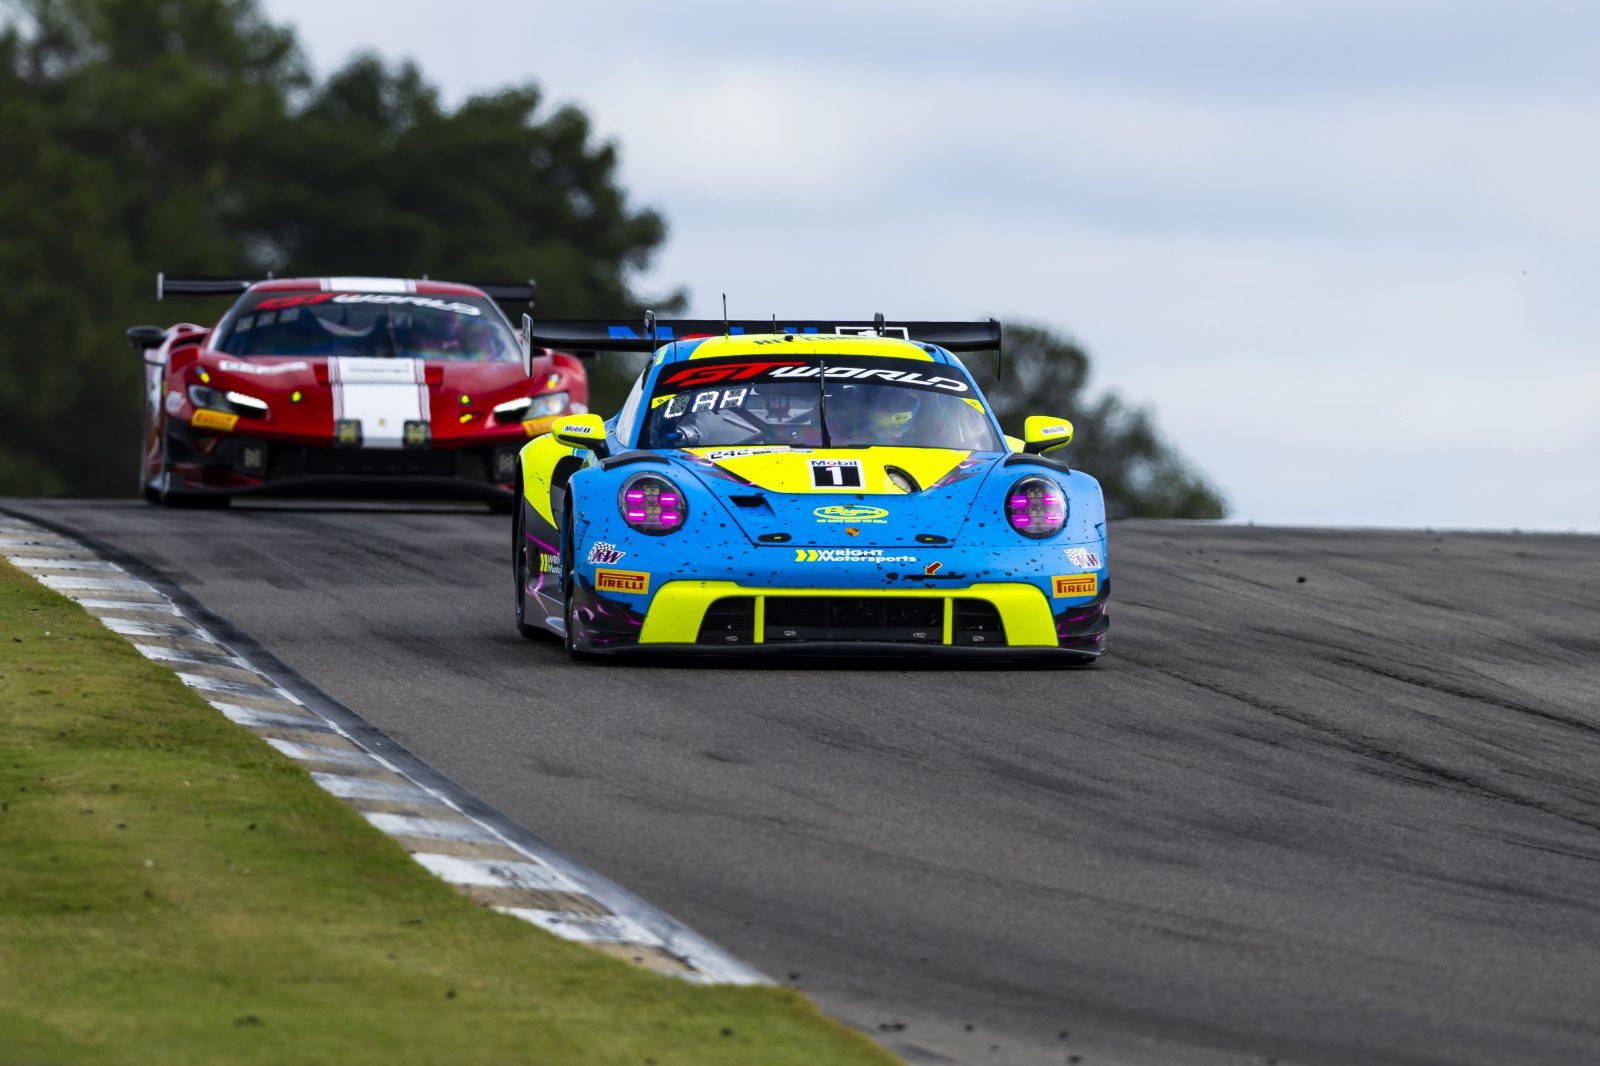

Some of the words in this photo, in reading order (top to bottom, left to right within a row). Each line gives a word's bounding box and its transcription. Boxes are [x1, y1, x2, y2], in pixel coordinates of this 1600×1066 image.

[825, 466, 843, 485] 1
[816, 555, 918, 565] Motorsports
[598, 572, 645, 590] PIRELLI
[1056, 577, 1095, 594] PIRELLI
